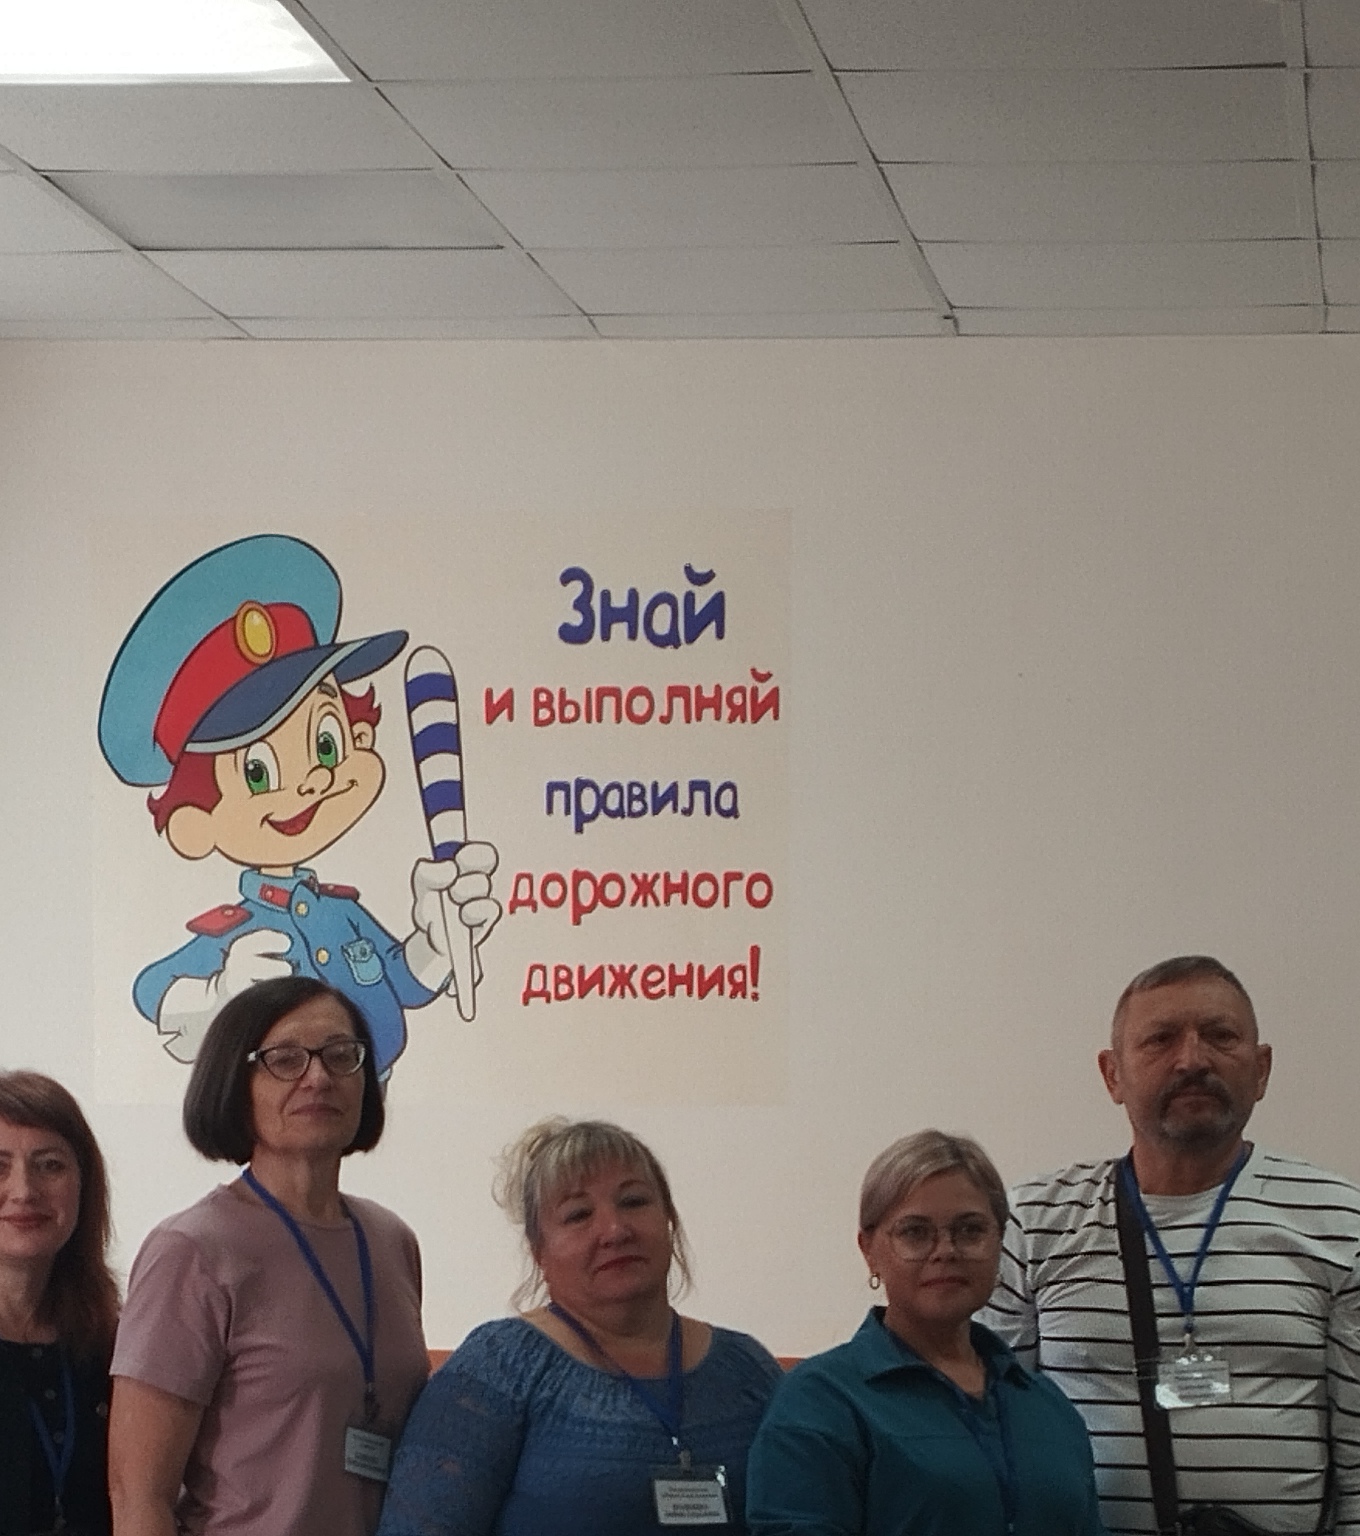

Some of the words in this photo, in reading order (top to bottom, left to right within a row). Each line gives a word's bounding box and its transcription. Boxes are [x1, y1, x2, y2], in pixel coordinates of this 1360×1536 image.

[558, 563, 726, 650] Знай
[484, 687, 515, 726] и
[532, 667, 781, 727] выполняй
[545, 777, 740, 834] правила
[508, 869, 774, 926] дорожного
[522, 945, 761, 1006] движения!
